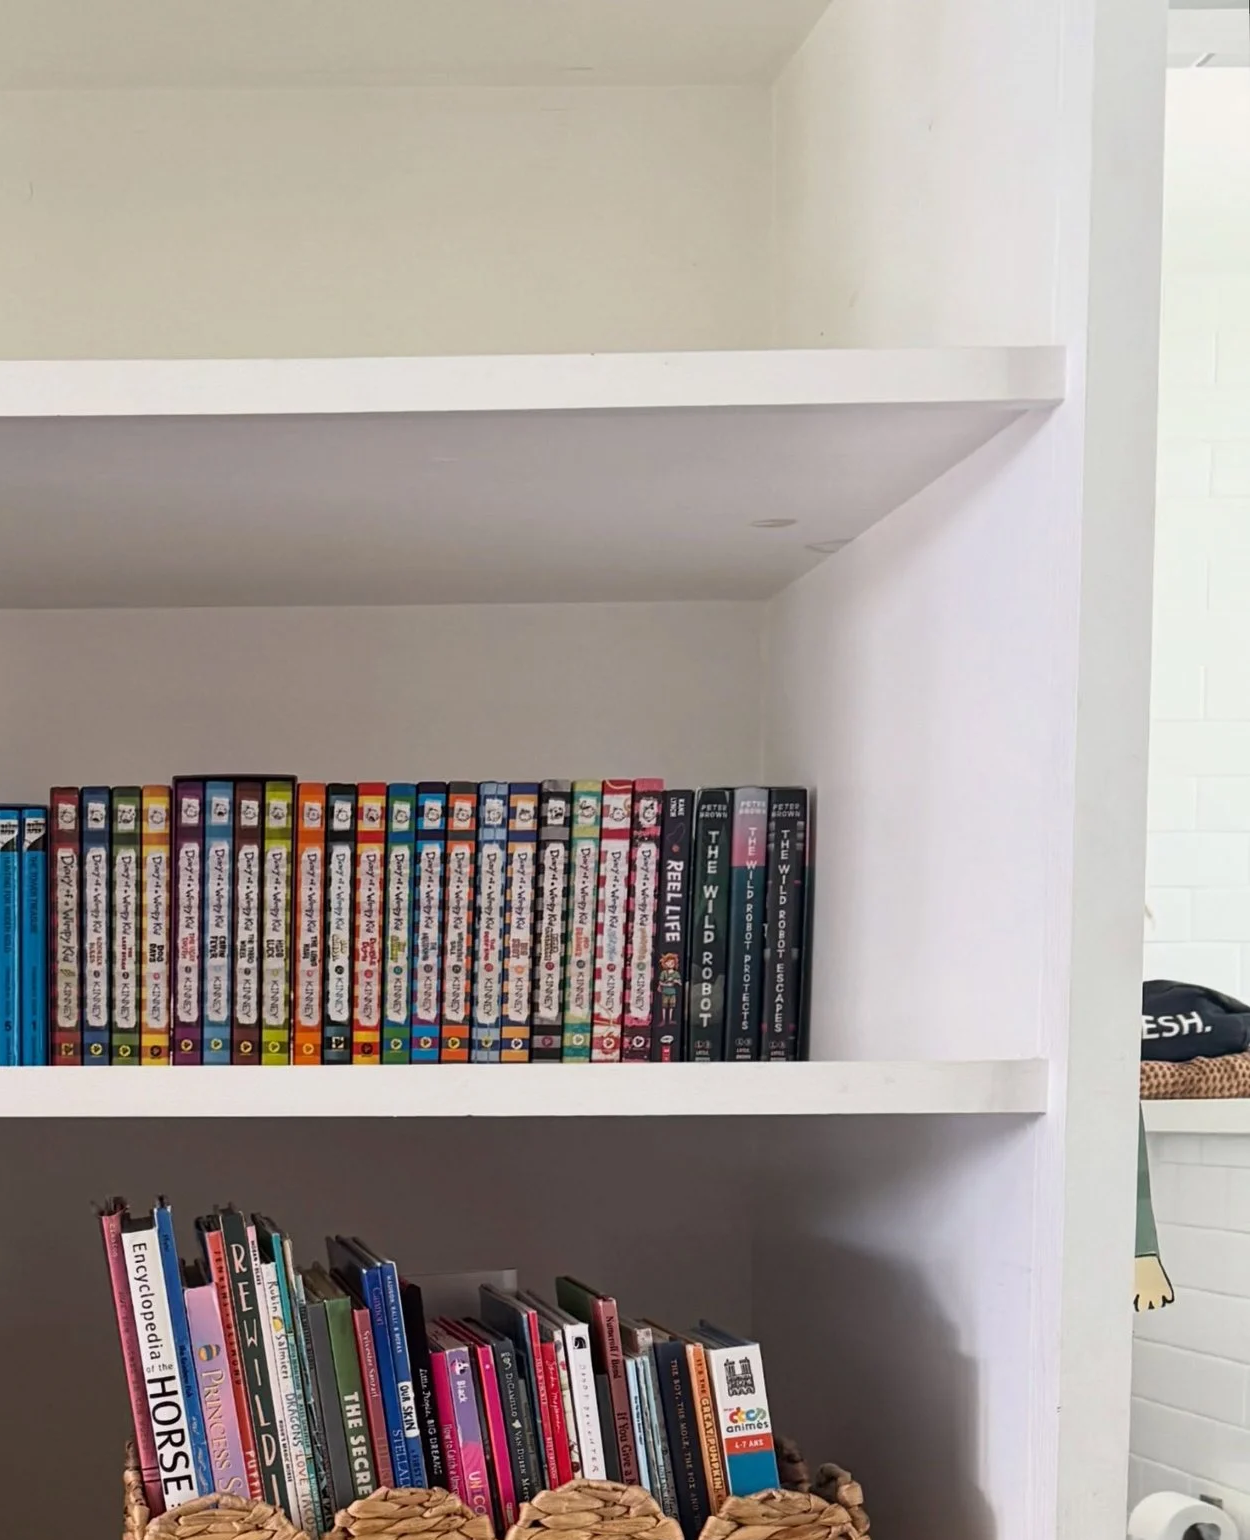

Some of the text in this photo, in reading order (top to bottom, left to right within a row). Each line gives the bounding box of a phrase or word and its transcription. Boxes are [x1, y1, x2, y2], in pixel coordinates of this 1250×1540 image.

[665, 860, 684, 941] REEL LIFE
[702, 885, 719, 944] WILD
[63, 982, 74, 1020] KINNEY
[699, 952, 713, 1028] ROBOT
[132, 1243, 163, 1360] Encyclopedia
[158, 1362, 174, 1371] the
[670, 1359, 679, 1376] THE
[344, 1392, 362, 1428] THE
[400, 1385, 414, 1431] OUR SKIN
[457, 1381, 467, 1402] Black
[147, 1376, 193, 1495] HORSE
[201, 1369, 234, 1469] PRINCESS
[426, 1420, 437, 1435] BIG
[618, 1423, 629, 1442] You
[700, 1398, 716, 1435] GREAT
[283, 1393, 302, 1447] DRAGONS
[295, 1454, 307, 1485] LOVE
[621, 1445, 634, 1468] Give
